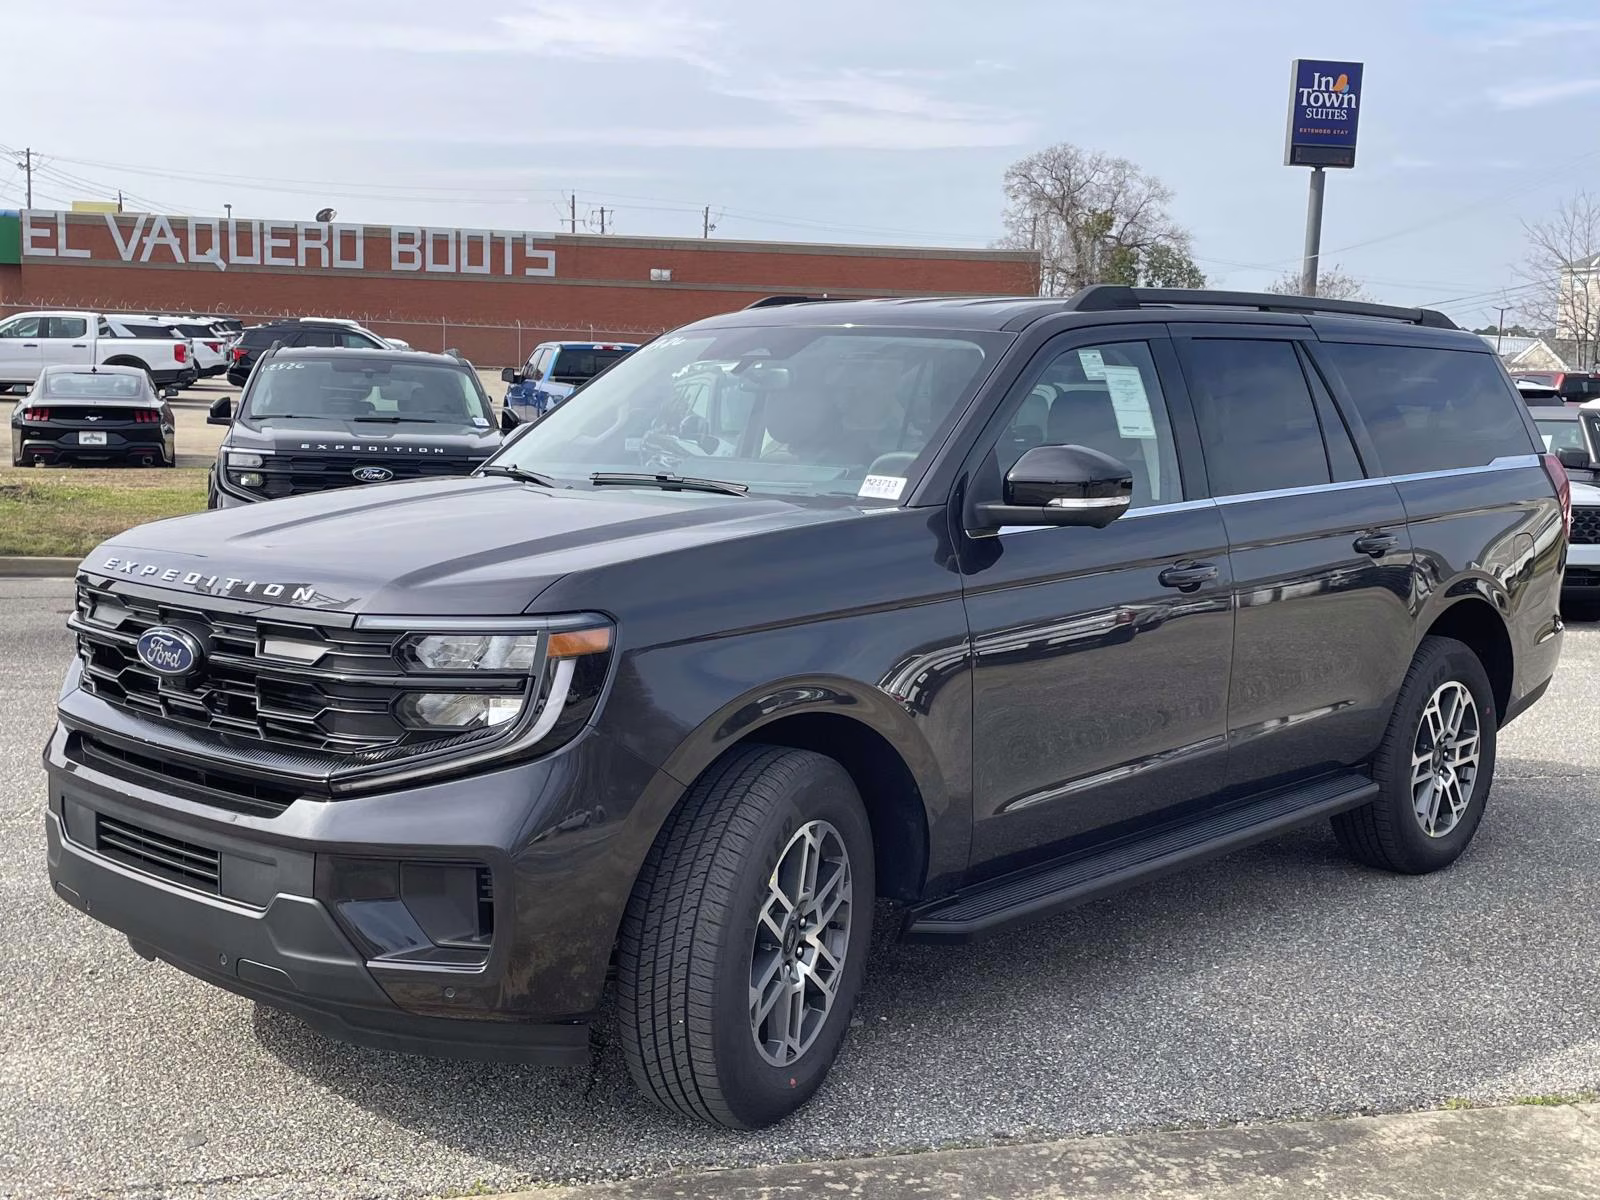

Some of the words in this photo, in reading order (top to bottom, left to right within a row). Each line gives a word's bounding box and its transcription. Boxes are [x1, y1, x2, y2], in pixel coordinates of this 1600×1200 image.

[1312, 72, 1334, 91] In
[1305, 107, 1348, 120] SUITES
[1299, 127, 1331, 135] EXTENDED
[22, 209, 91, 258] EL
[104, 212, 364, 272] VAQUERO
[390, 225, 556, 277] BOOTS
[300, 443, 445, 454] EXPEDITION
[360, 468, 386, 481] Ford
[103, 557, 317, 602] EXPEDITION
[146, 635, 182, 669] Ford
